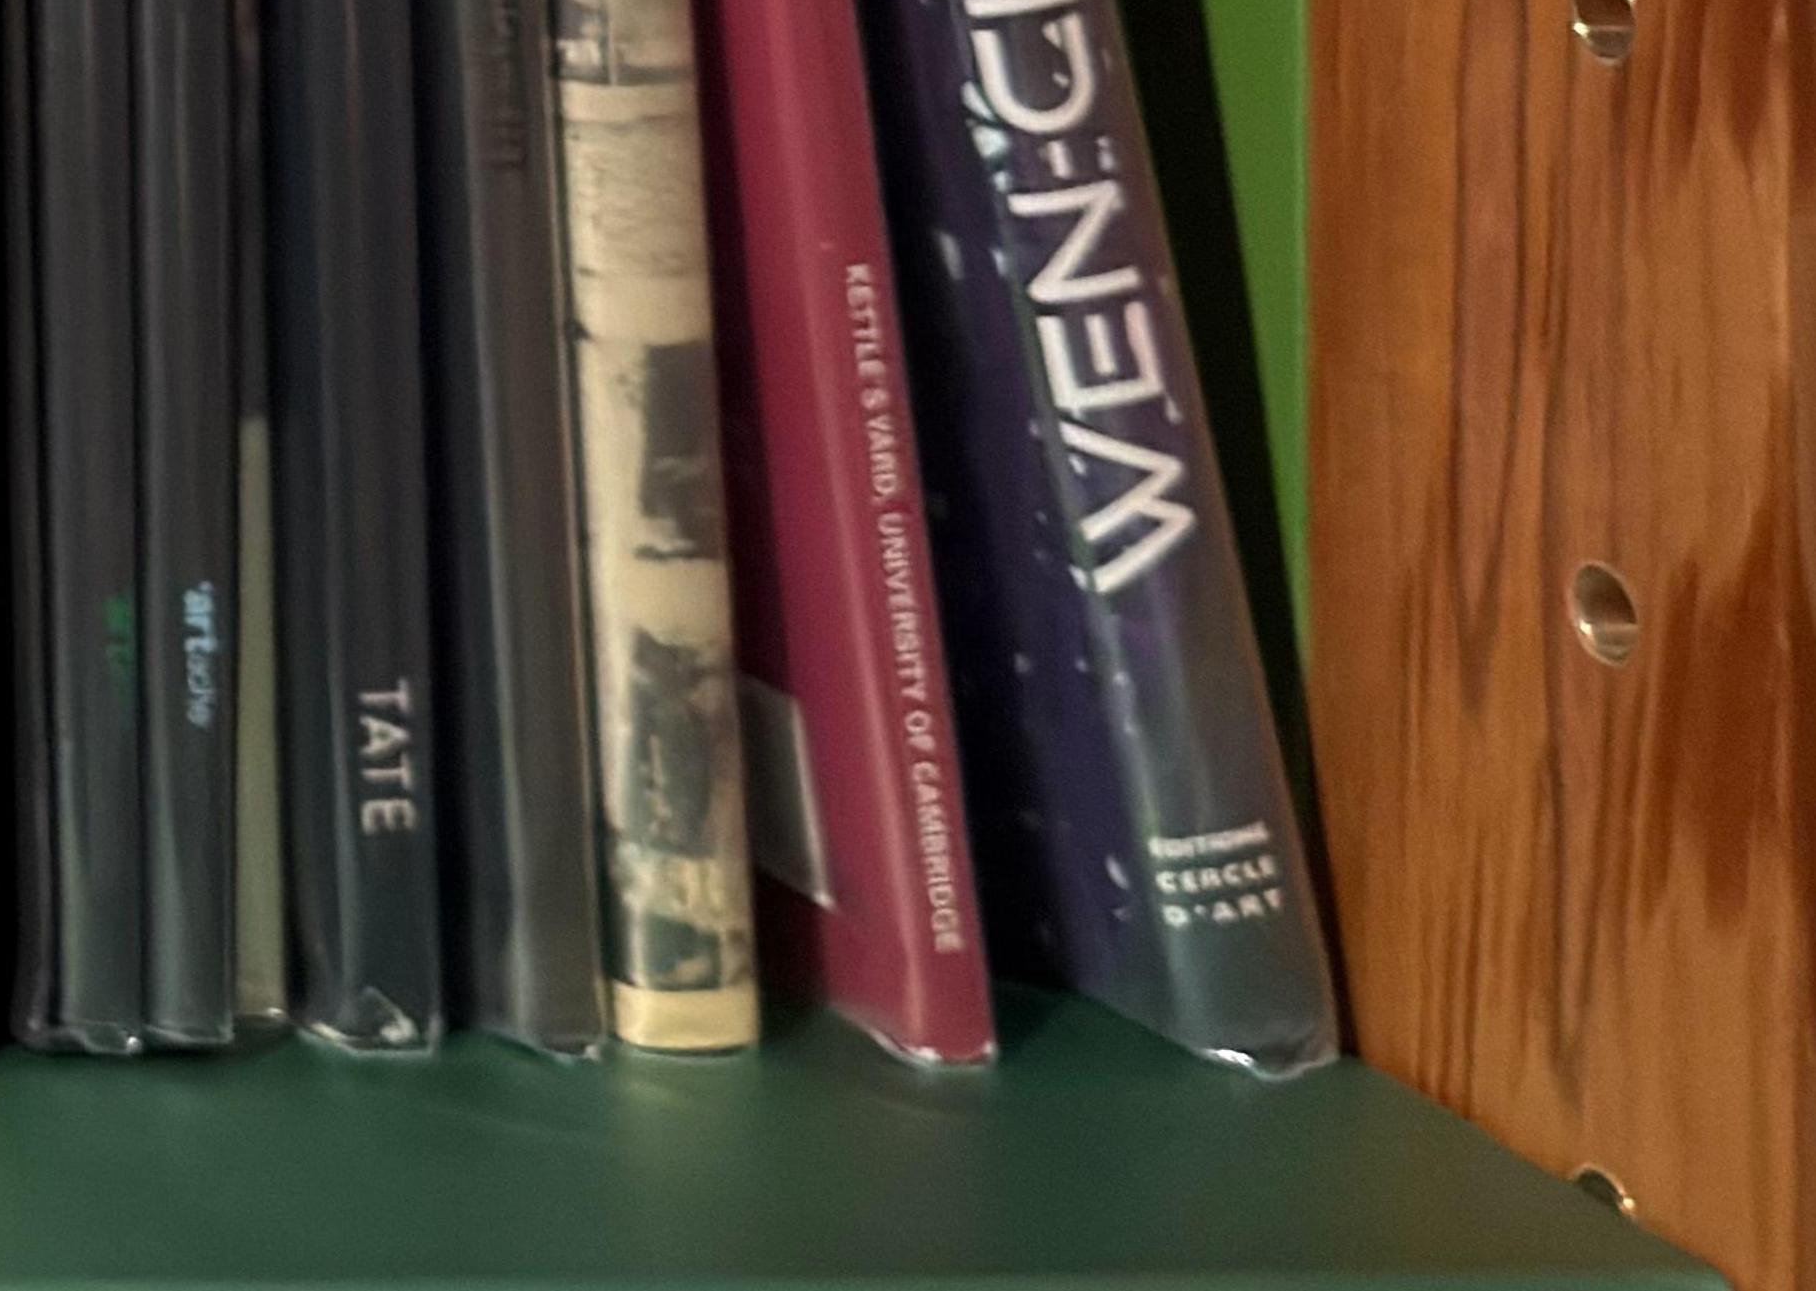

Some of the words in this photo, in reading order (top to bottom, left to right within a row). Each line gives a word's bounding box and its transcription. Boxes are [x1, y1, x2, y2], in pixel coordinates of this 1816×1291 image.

[877, 513, 926, 702] UNIVERSITY
[358, 678, 418, 836] TATE
[905, 709, 936, 752] OF
[911, 760, 966, 955] CAMBRIDGE
